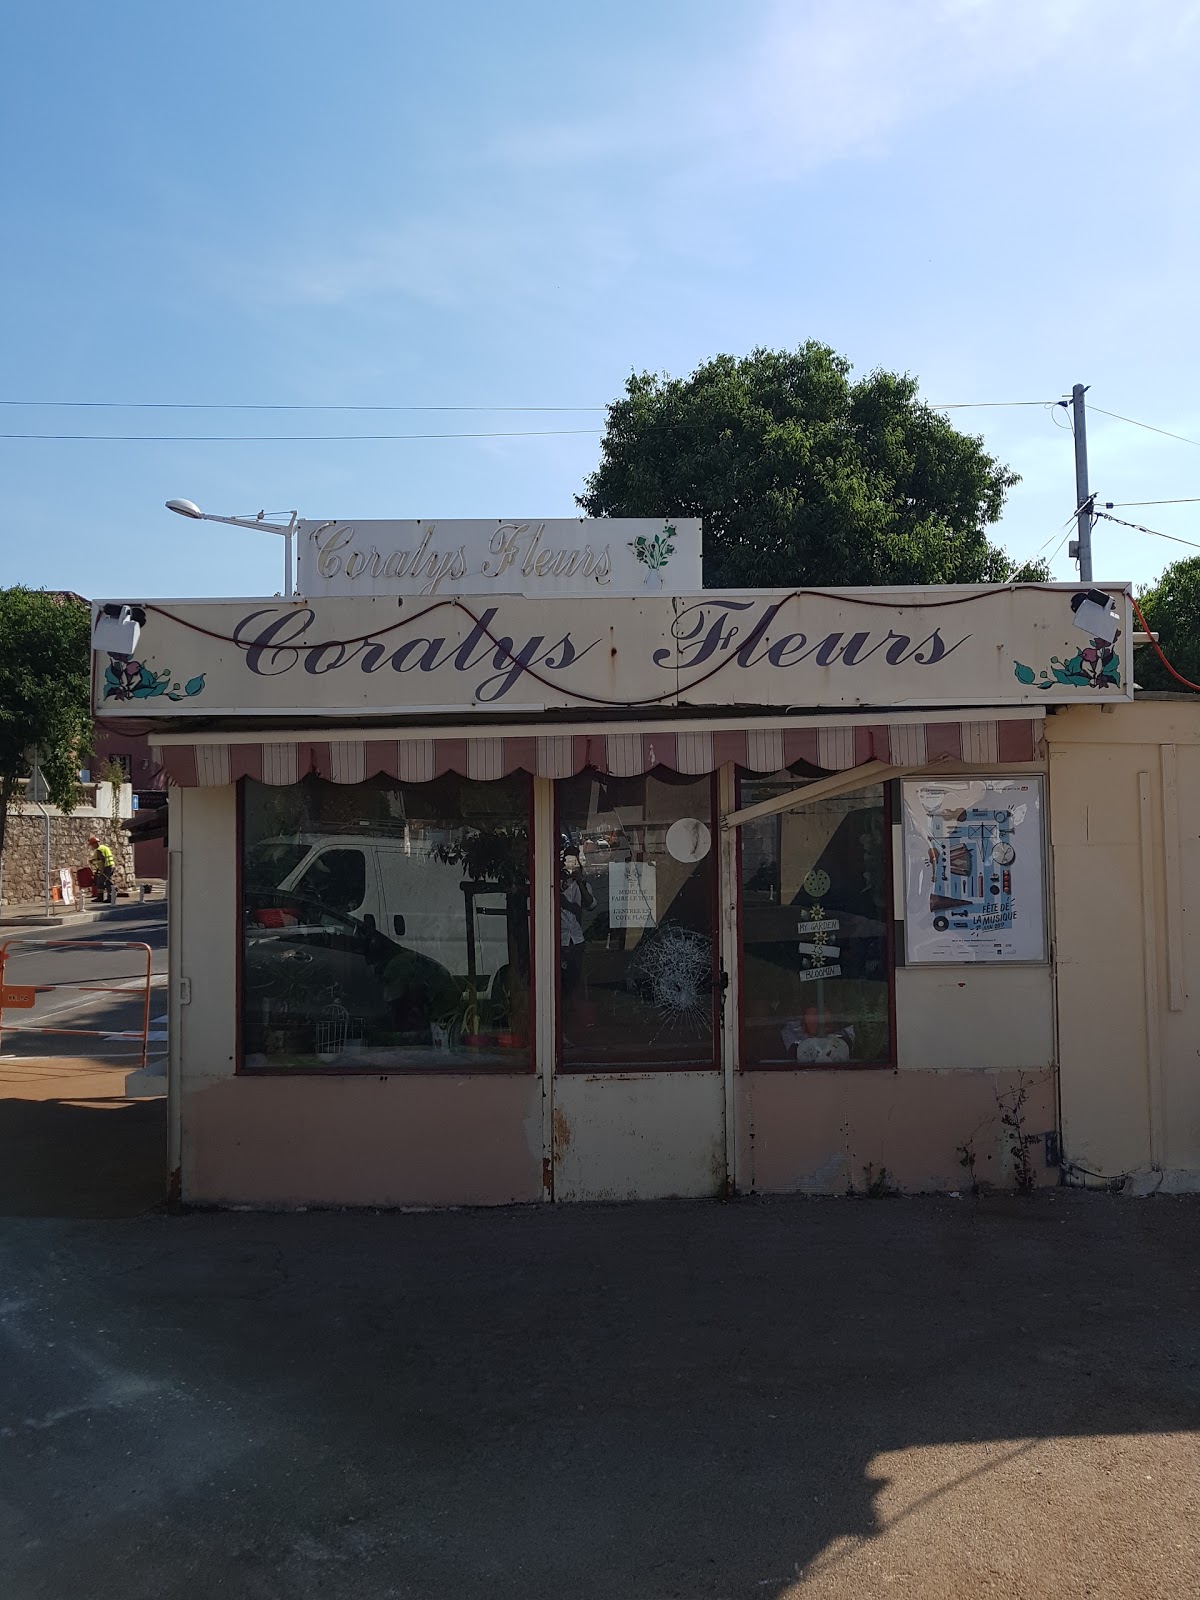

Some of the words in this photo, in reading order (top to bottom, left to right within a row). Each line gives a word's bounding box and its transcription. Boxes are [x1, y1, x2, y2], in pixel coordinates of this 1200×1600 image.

[309, 521, 468, 595] Coralys
[482, 522, 613, 585] Fleurs
[232, 606, 604, 703] Coralys
[652, 600, 974, 675] Fleurs
[982, 902, 998, 914] FÊTE
[1000, 902, 1010, 912] DE
[973, 915, 982, 924] LA
[982, 911, 1017, 925] MUSIQUE
[800, 924, 808, 932] MY
[810, 921, 837, 931] GARDEN
[812, 946, 824, 954] IS
